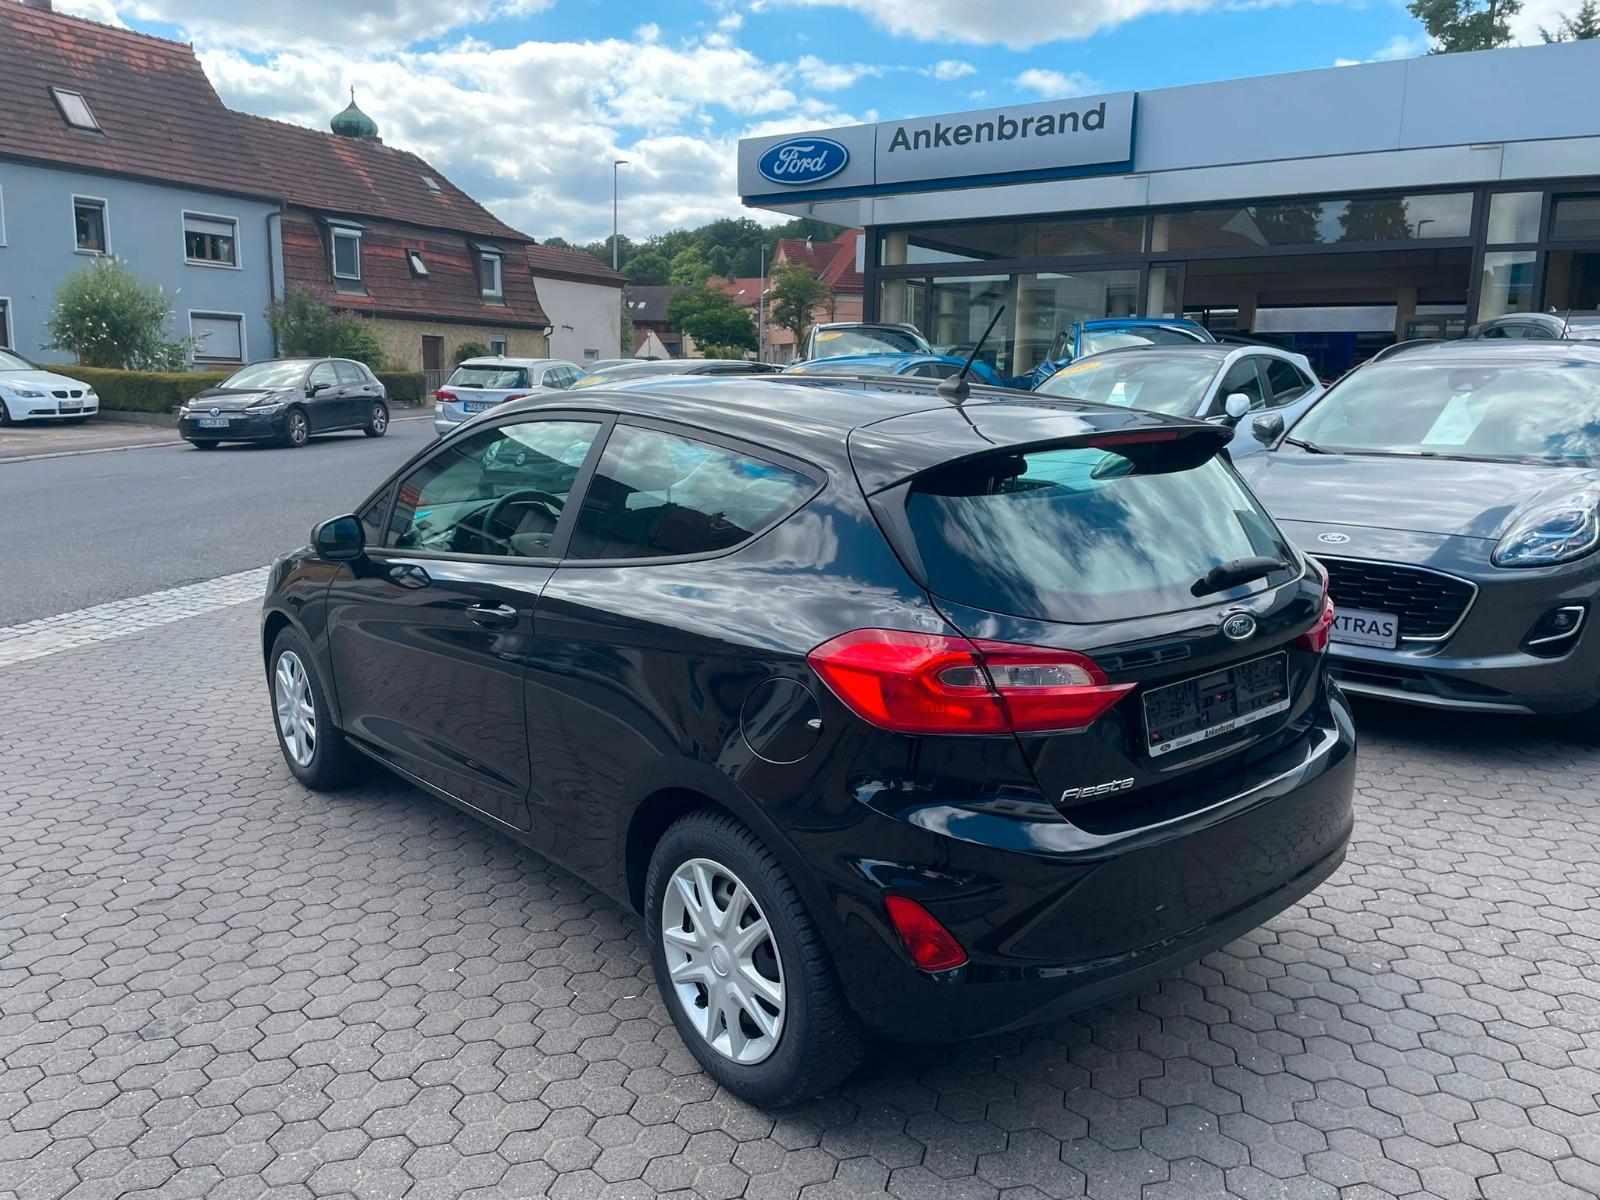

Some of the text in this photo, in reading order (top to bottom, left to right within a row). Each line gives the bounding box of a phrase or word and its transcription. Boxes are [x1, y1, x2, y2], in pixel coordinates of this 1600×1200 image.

[888, 102, 1106, 153] Ankenbrand
[773, 144, 827, 176] Ford
[1203, 720, 1236, 739] Ankenbrand
[1060, 776, 1135, 802] Fiesta
